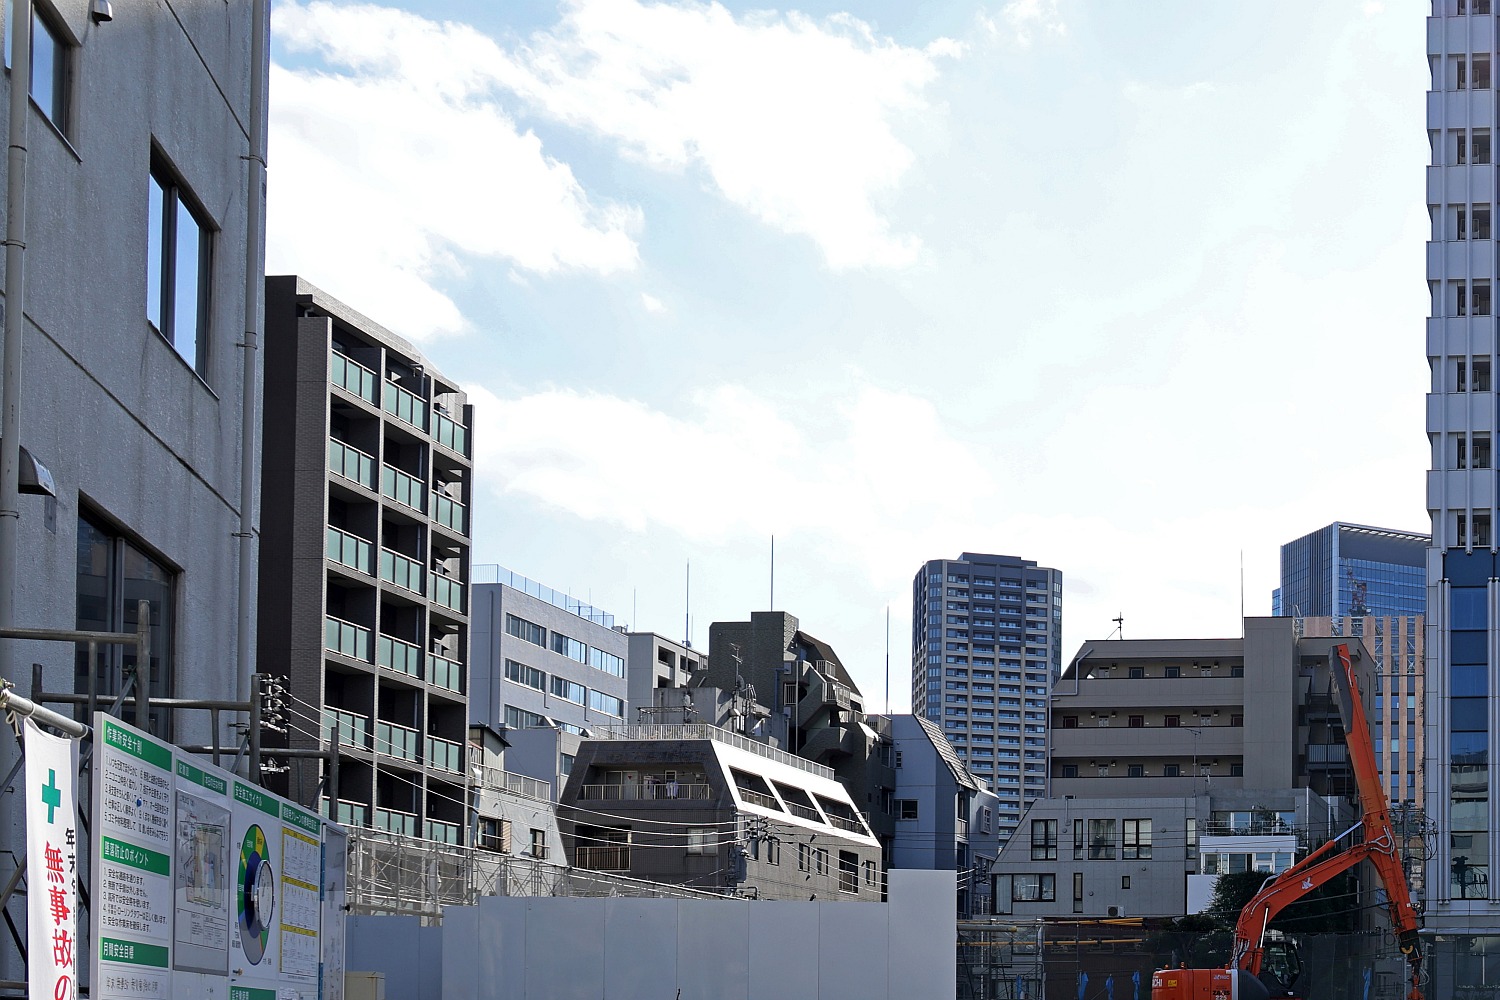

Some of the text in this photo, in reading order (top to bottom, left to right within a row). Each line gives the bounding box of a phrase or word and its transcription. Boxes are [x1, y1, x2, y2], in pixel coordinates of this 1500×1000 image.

[102, 940, 134, 960] 月間安全目標
